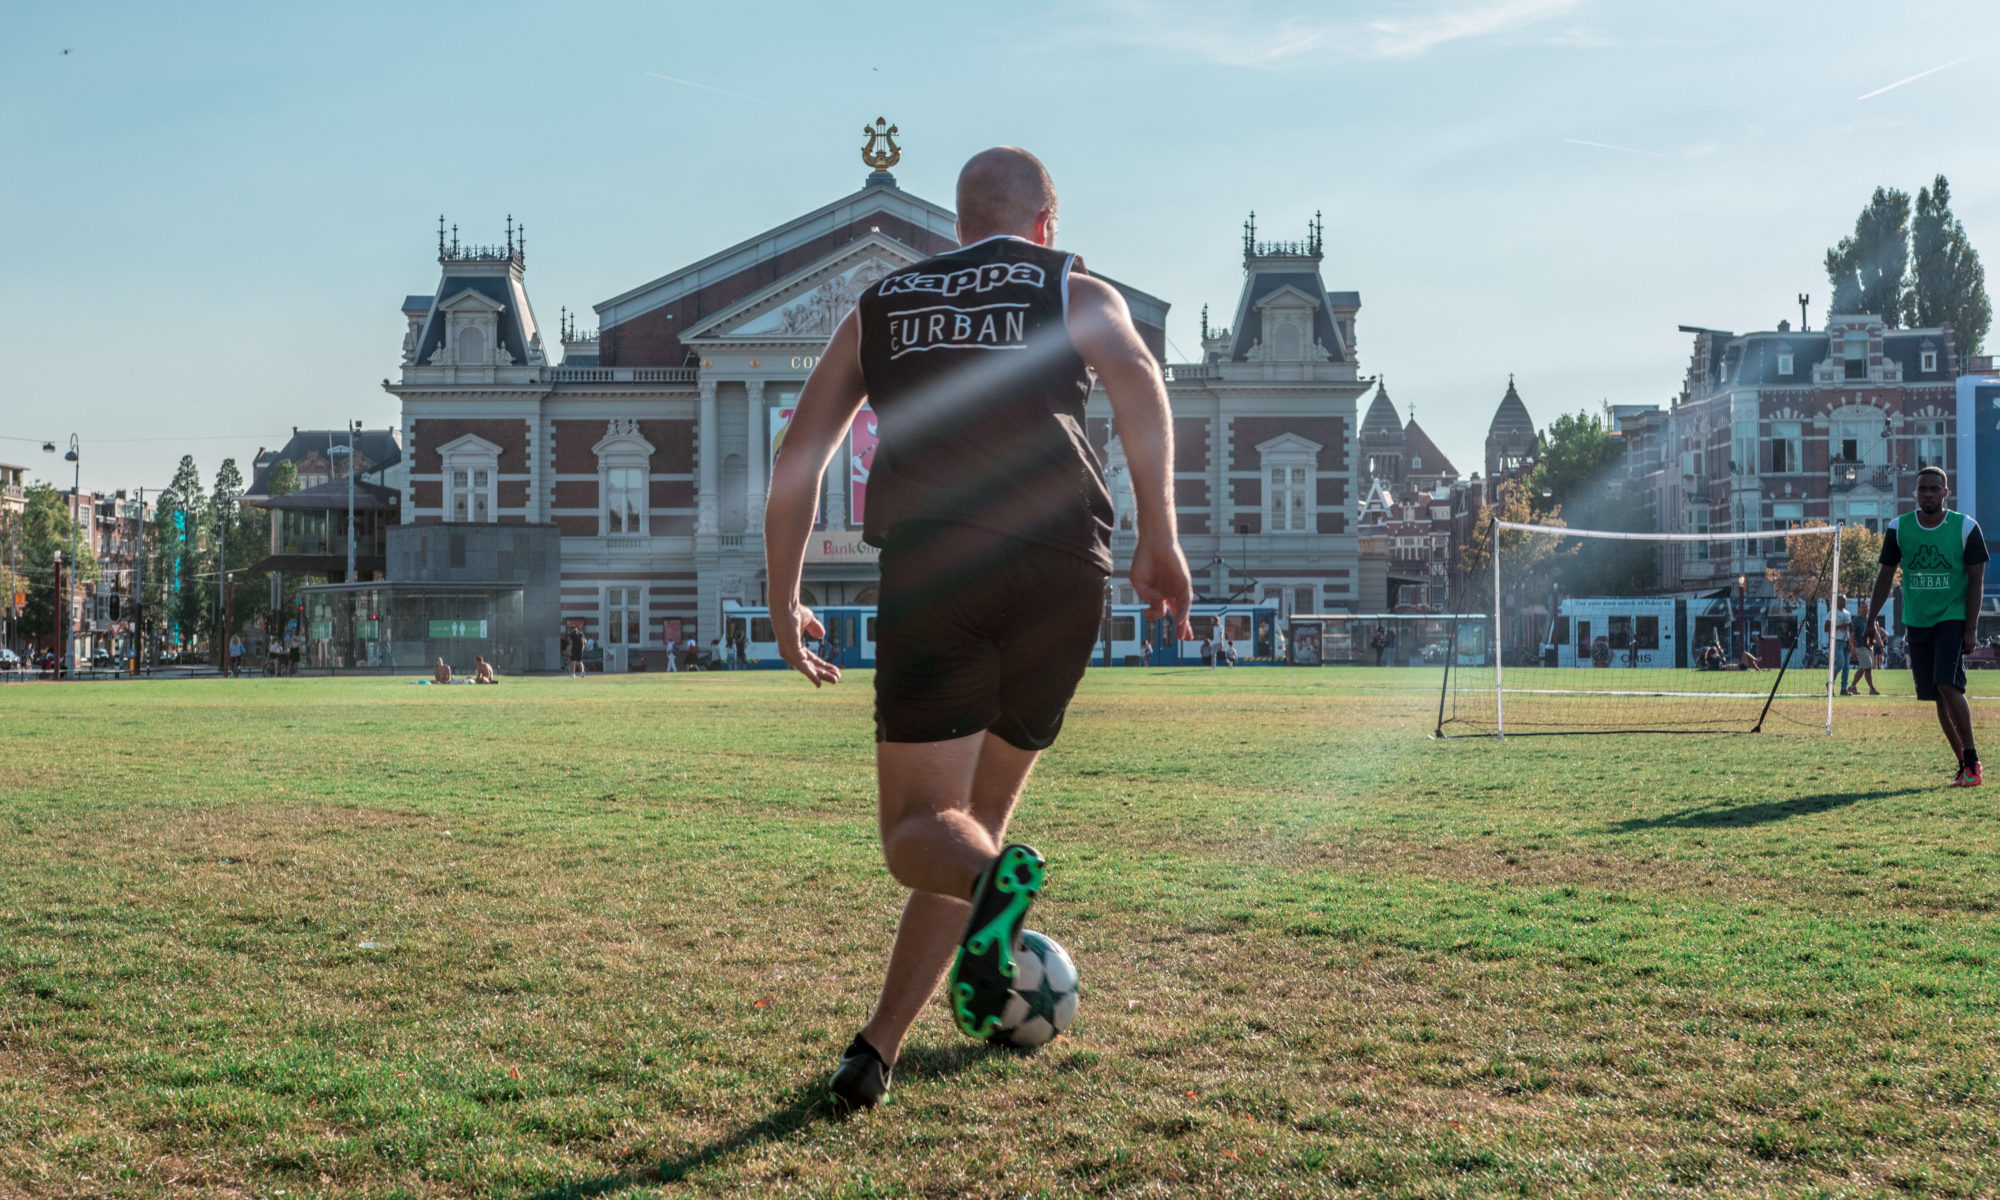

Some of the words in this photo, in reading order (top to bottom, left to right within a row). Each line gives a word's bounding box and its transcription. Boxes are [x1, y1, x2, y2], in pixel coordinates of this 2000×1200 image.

[878, 262, 1045, 297] Kappa
[902, 311, 1024, 345] URBAN
[1913, 576, 1950, 587] URBAN
